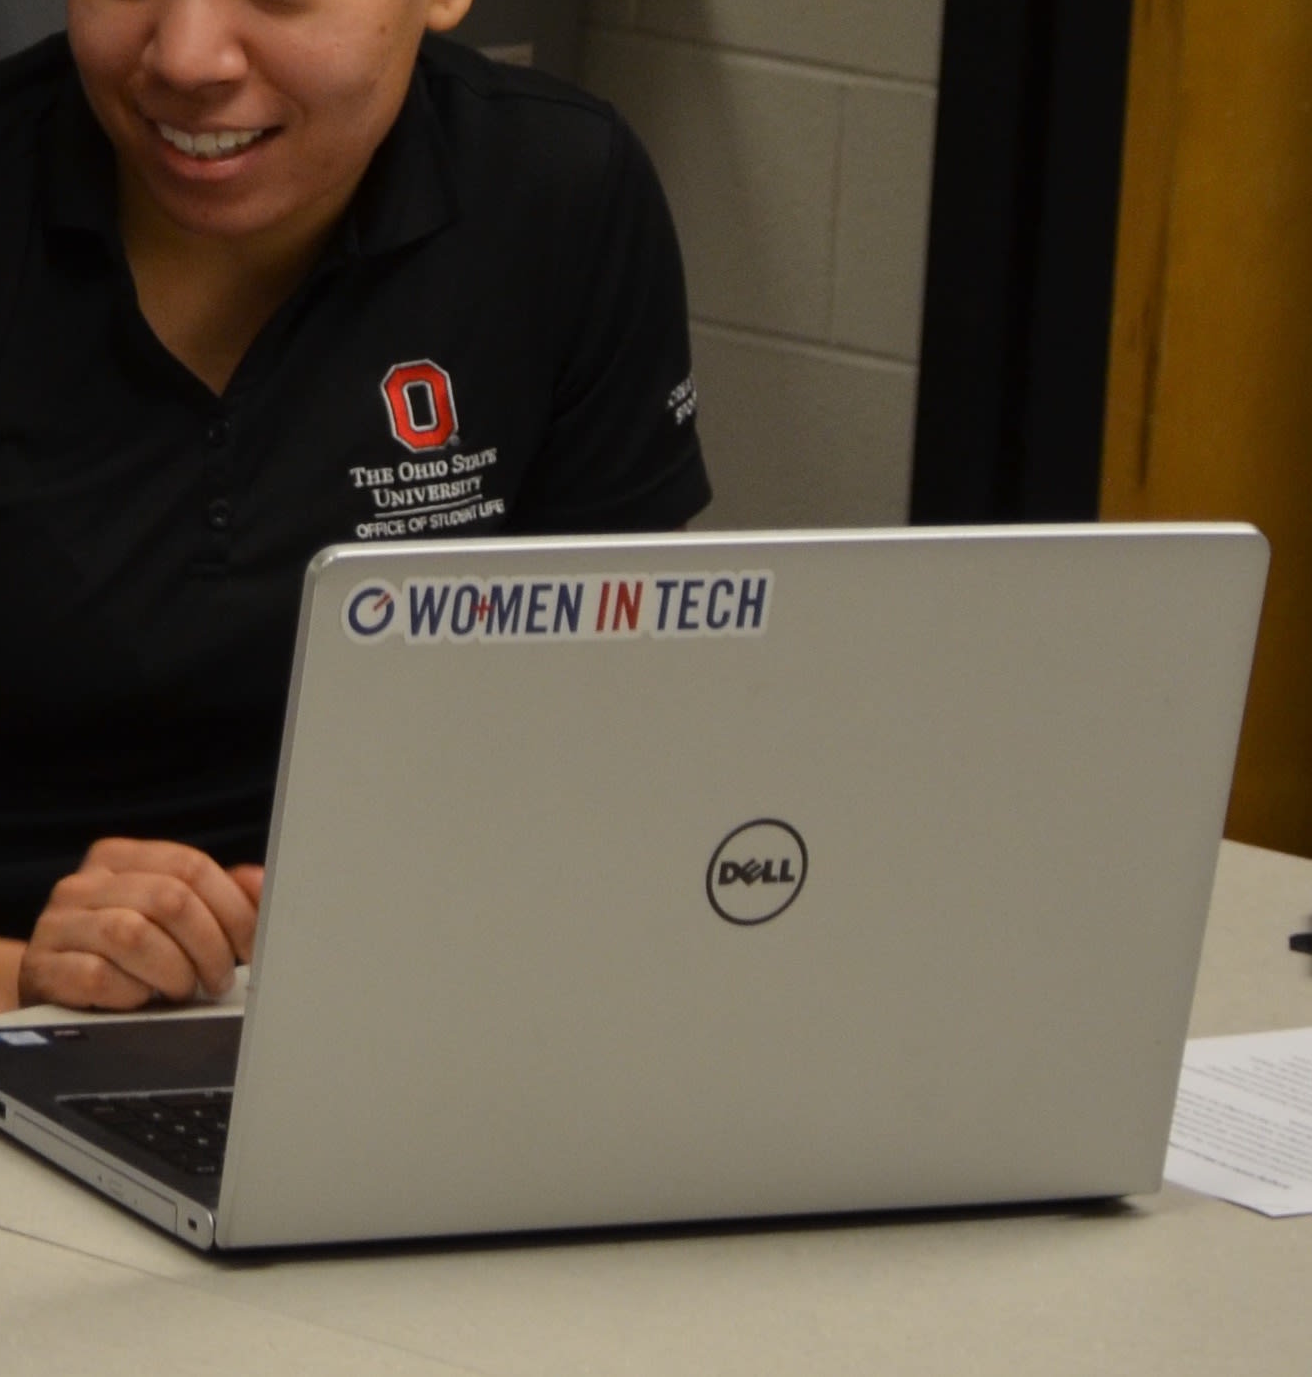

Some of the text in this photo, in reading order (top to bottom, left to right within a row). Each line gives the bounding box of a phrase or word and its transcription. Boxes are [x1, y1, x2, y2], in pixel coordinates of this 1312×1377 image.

[349, 466, 395, 489] THE
[397, 461, 448, 482] OHIO
[372, 475, 483, 508] UNIVERSITY
[356, 519, 406, 539] OFFICE
[408, 515, 427, 533] OF
[479, 498, 506, 518] LIFE
[408, 577, 768, 637] WOMEN IN TECH
[718, 857, 796, 886] DELL
